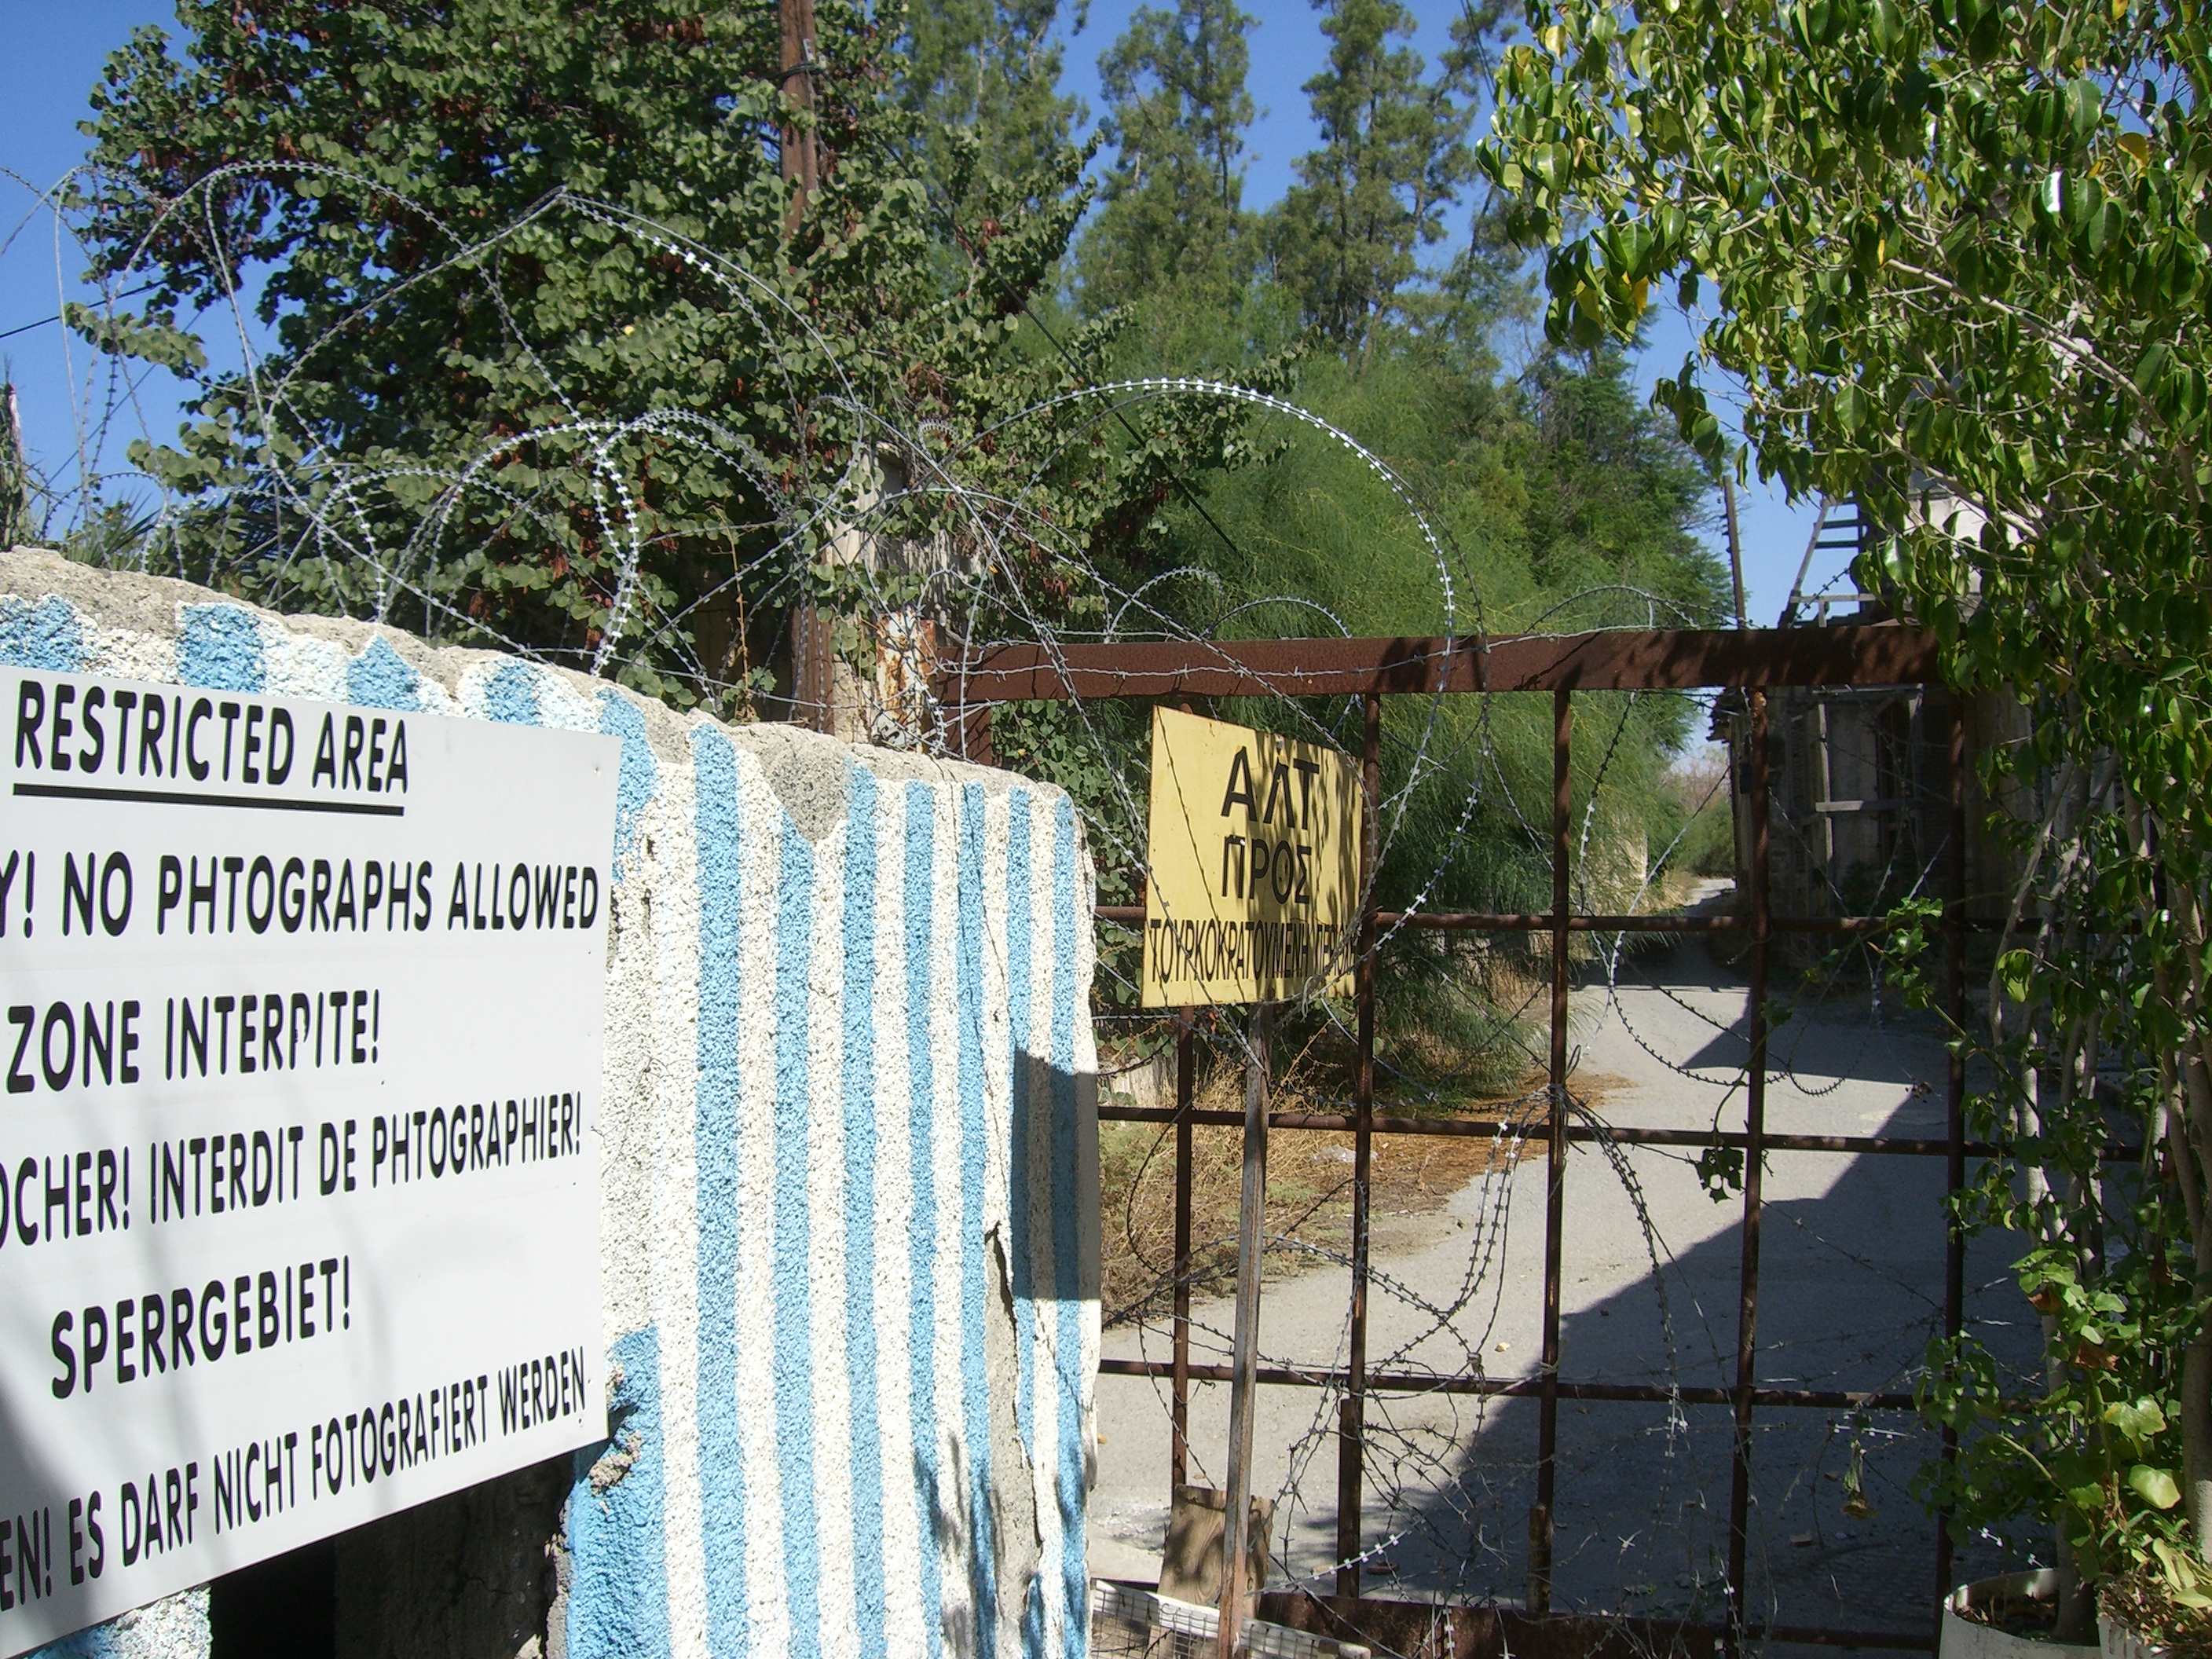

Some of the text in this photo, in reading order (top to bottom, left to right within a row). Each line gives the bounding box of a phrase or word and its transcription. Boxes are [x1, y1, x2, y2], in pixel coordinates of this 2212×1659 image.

[15, 679, 408, 794] RESTRICTED AREA
[1220, 745, 1320, 830] ΑΛΤ
[62, 850, 134, 937] NO
[157, 854, 433, 936] PHTOGRAPHS
[447, 861, 599, 932] ALLOWED
[1221, 833, 1312, 905] ΠΡΟΣ
[5, 1000, 141, 1094] ZONE
[0, 1090, 582, 1251] CHER! INTERDIT DE PHTOGRAPHIER!
[51, 1254, 350, 1400] SPERRGEBIET!
[68, 1490, 105, 1587] ES
[120, 1461, 200, 1568] DARF
[213, 1431, 298, 1536] NICHT
[311, 1374, 489, 1500] FOTOGRAFIERT
[497, 1346, 587, 1436] WERDEN
